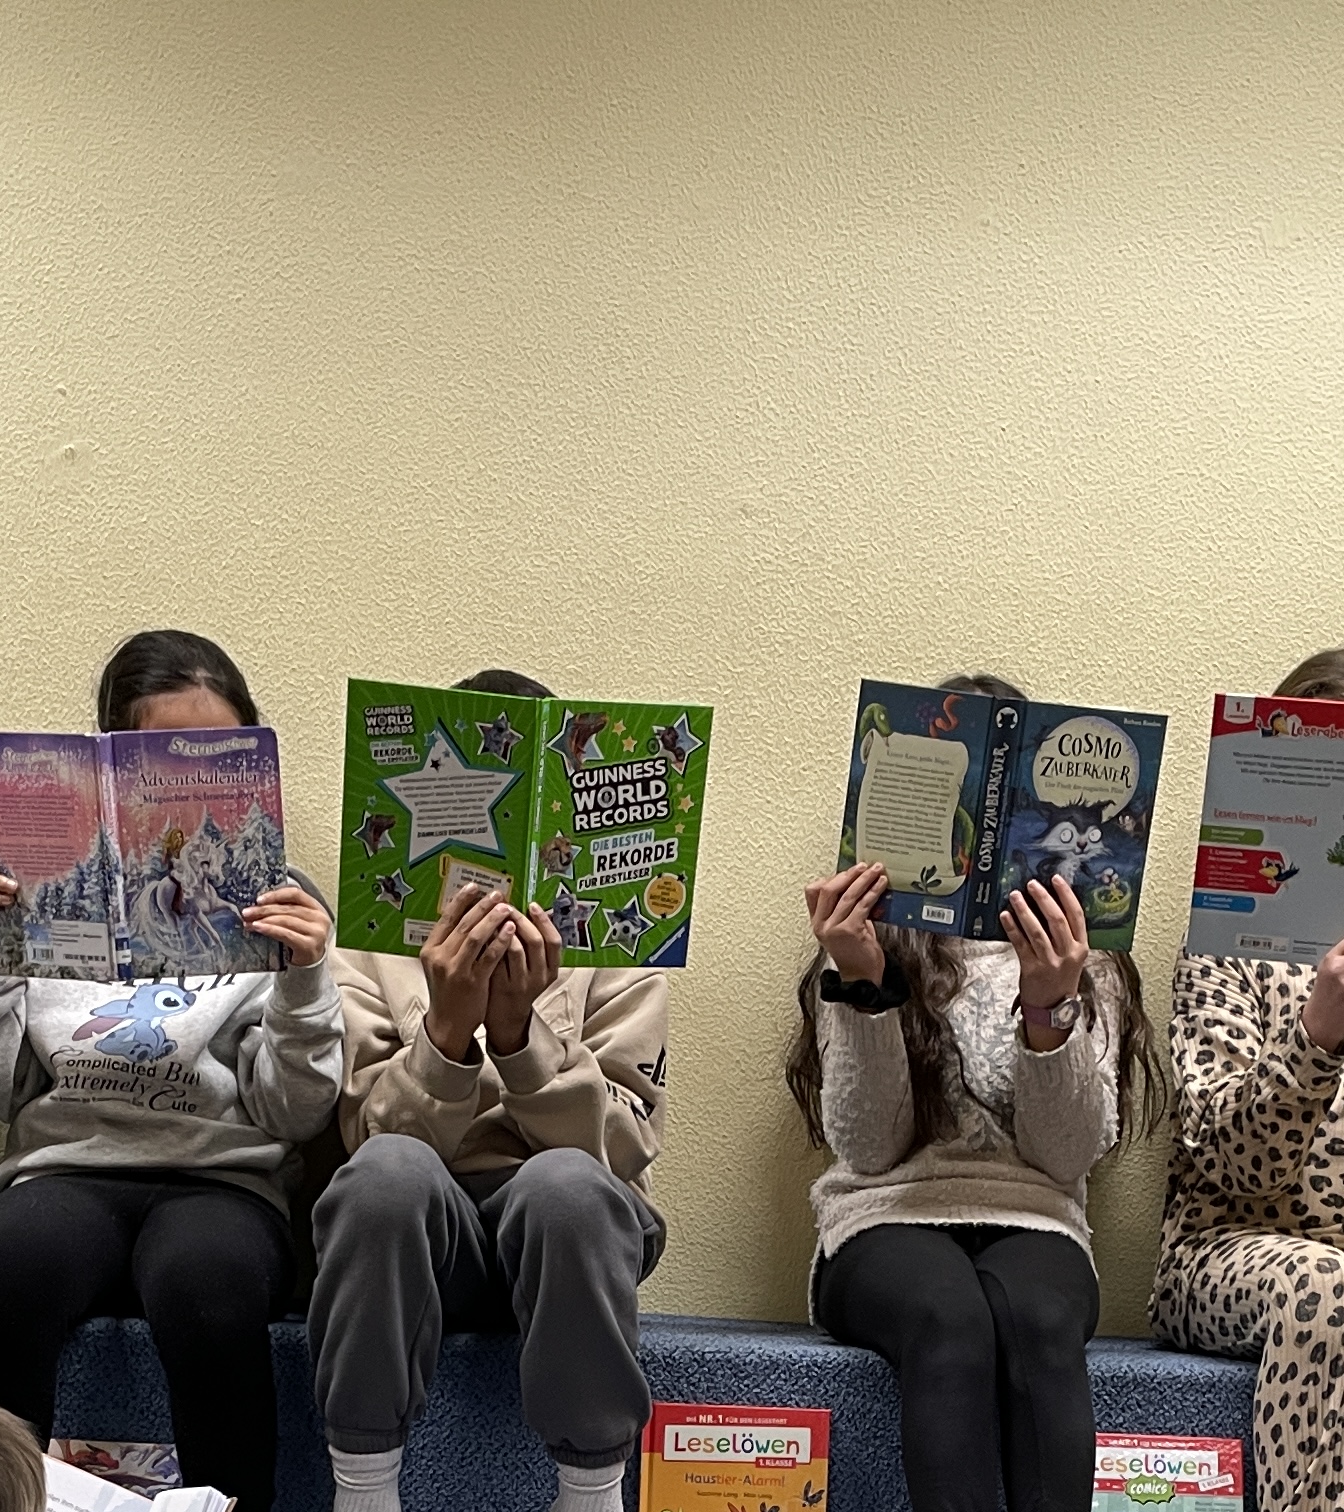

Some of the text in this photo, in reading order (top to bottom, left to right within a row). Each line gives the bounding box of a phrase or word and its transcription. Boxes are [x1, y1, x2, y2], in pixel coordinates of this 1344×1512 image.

[365, 715, 413, 727] WORLD
[366, 725, 415, 736] RECORDS
[572, 759, 667, 789] GUINNESS
[573, 779, 668, 812] WORLD
[574, 800, 669, 832] RECORDS
[592, 831, 653, 853] DIE BESTEN
[596, 841, 676, 873] REKORDE
[599, 867, 650, 887] ERSTLESER
[59, 1072, 153, 1098] xtremely
[148, 1084, 198, 1114] Cute
[674, 1431, 800, 1456] Leselöwen
[1095, 1453, 1212, 1477] eselöwen
[684, 1472, 786, 1488] Haustier-Alarm!
